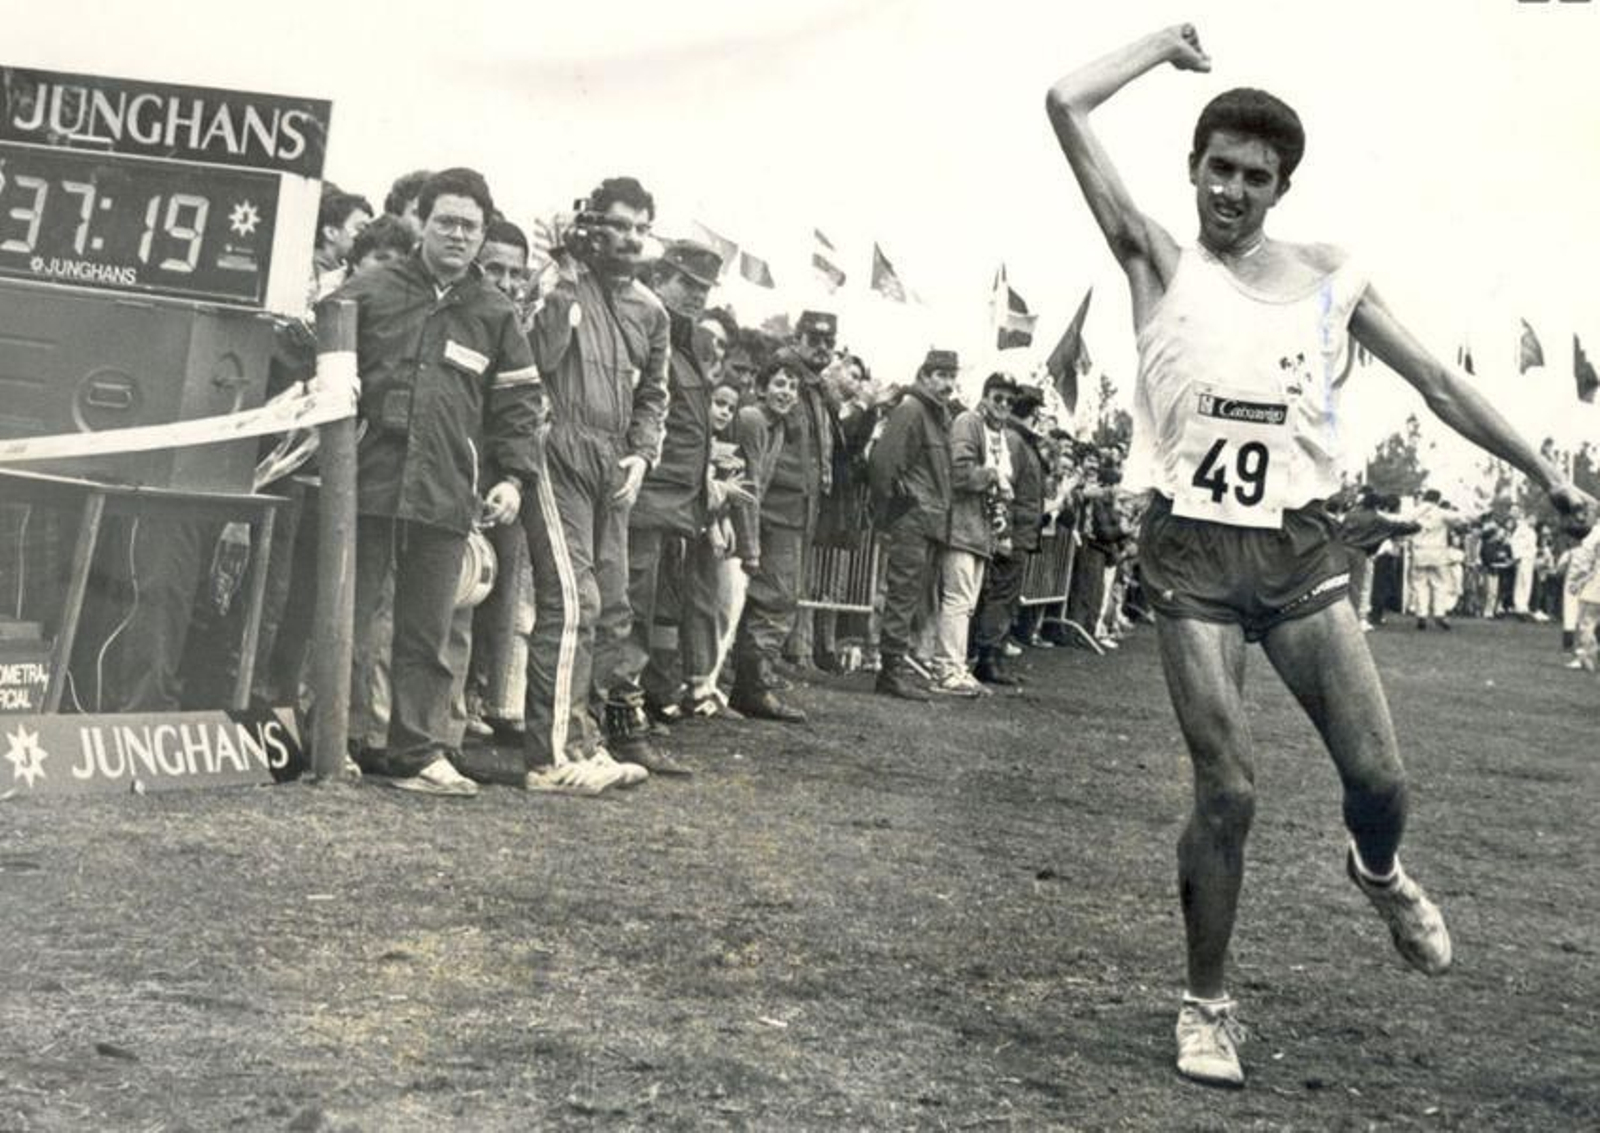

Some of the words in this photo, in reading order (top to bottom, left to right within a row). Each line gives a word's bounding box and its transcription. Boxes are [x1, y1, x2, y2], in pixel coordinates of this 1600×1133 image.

[13, 83, 306, 160] JUNGHANS
[45, 257, 137, 285] JUNGHANS
[1191, 438, 1269, 507] 49
[72, 721, 289, 779] JUNGHANS
